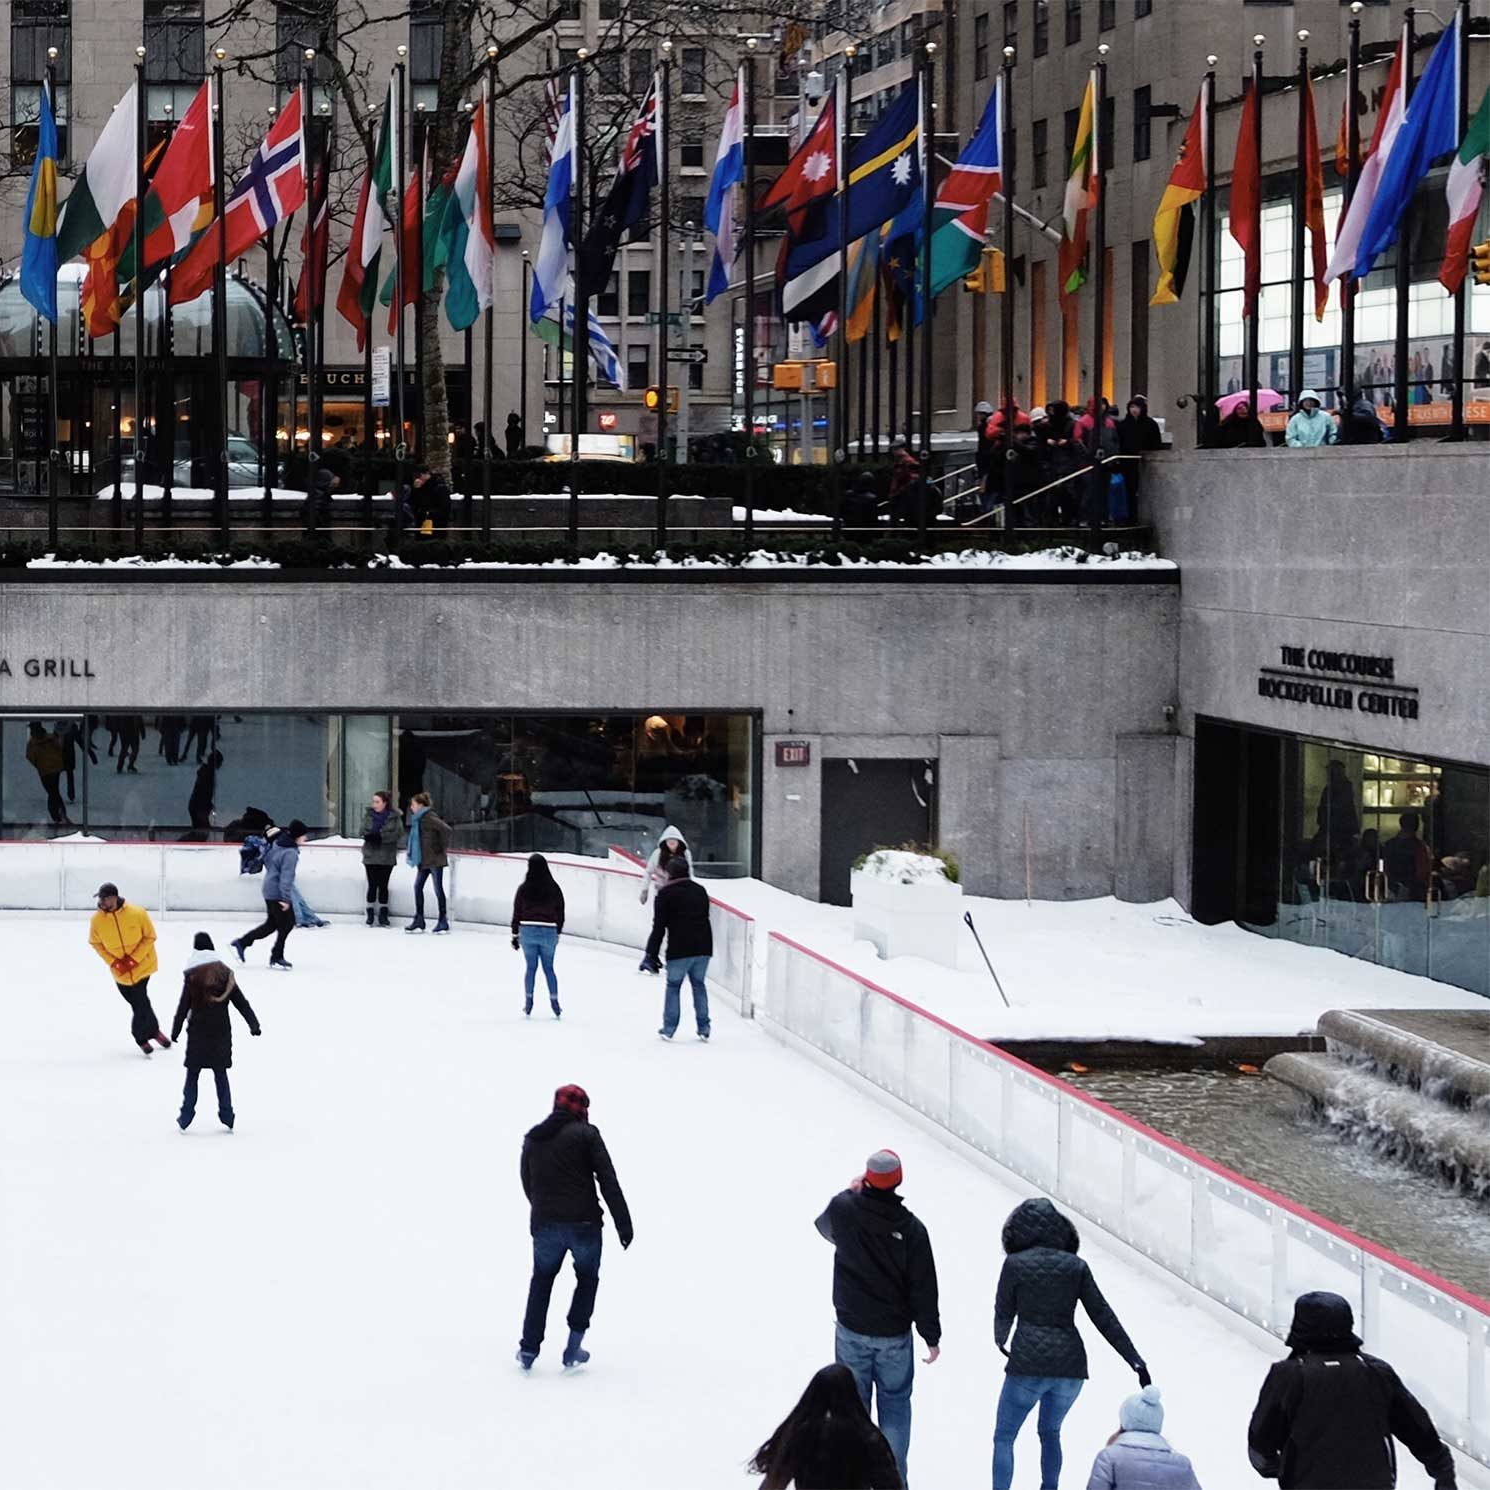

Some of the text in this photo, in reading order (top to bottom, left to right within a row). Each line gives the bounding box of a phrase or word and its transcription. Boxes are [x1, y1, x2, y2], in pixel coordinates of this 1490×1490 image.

[24, 658, 95, 678] GRILL
[1280, 645, 1395, 679] THE CONCOURSE
[1258, 677, 1420, 720] ROCKEFELLER CENTER
[783, 747, 804, 762] EXIT
